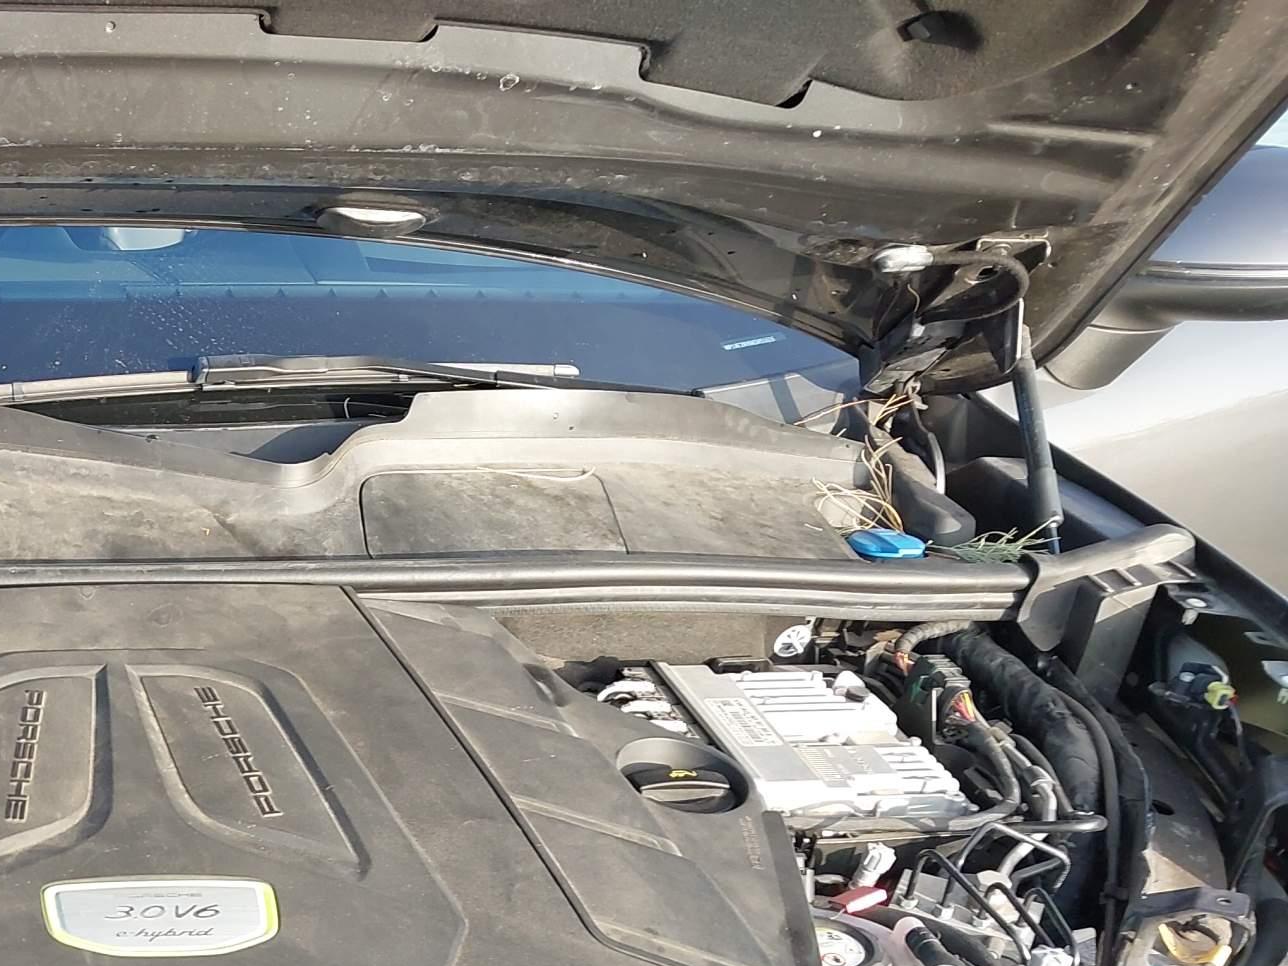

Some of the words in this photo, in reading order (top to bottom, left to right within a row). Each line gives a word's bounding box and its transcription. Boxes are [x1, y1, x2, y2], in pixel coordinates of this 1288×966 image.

[4, 689, 45, 821] PORSCHE
[193, 686, 282, 817] PORSCHE
[116, 927, 215, 943] e-hybrid
[173, 904, 222, 920] V6
